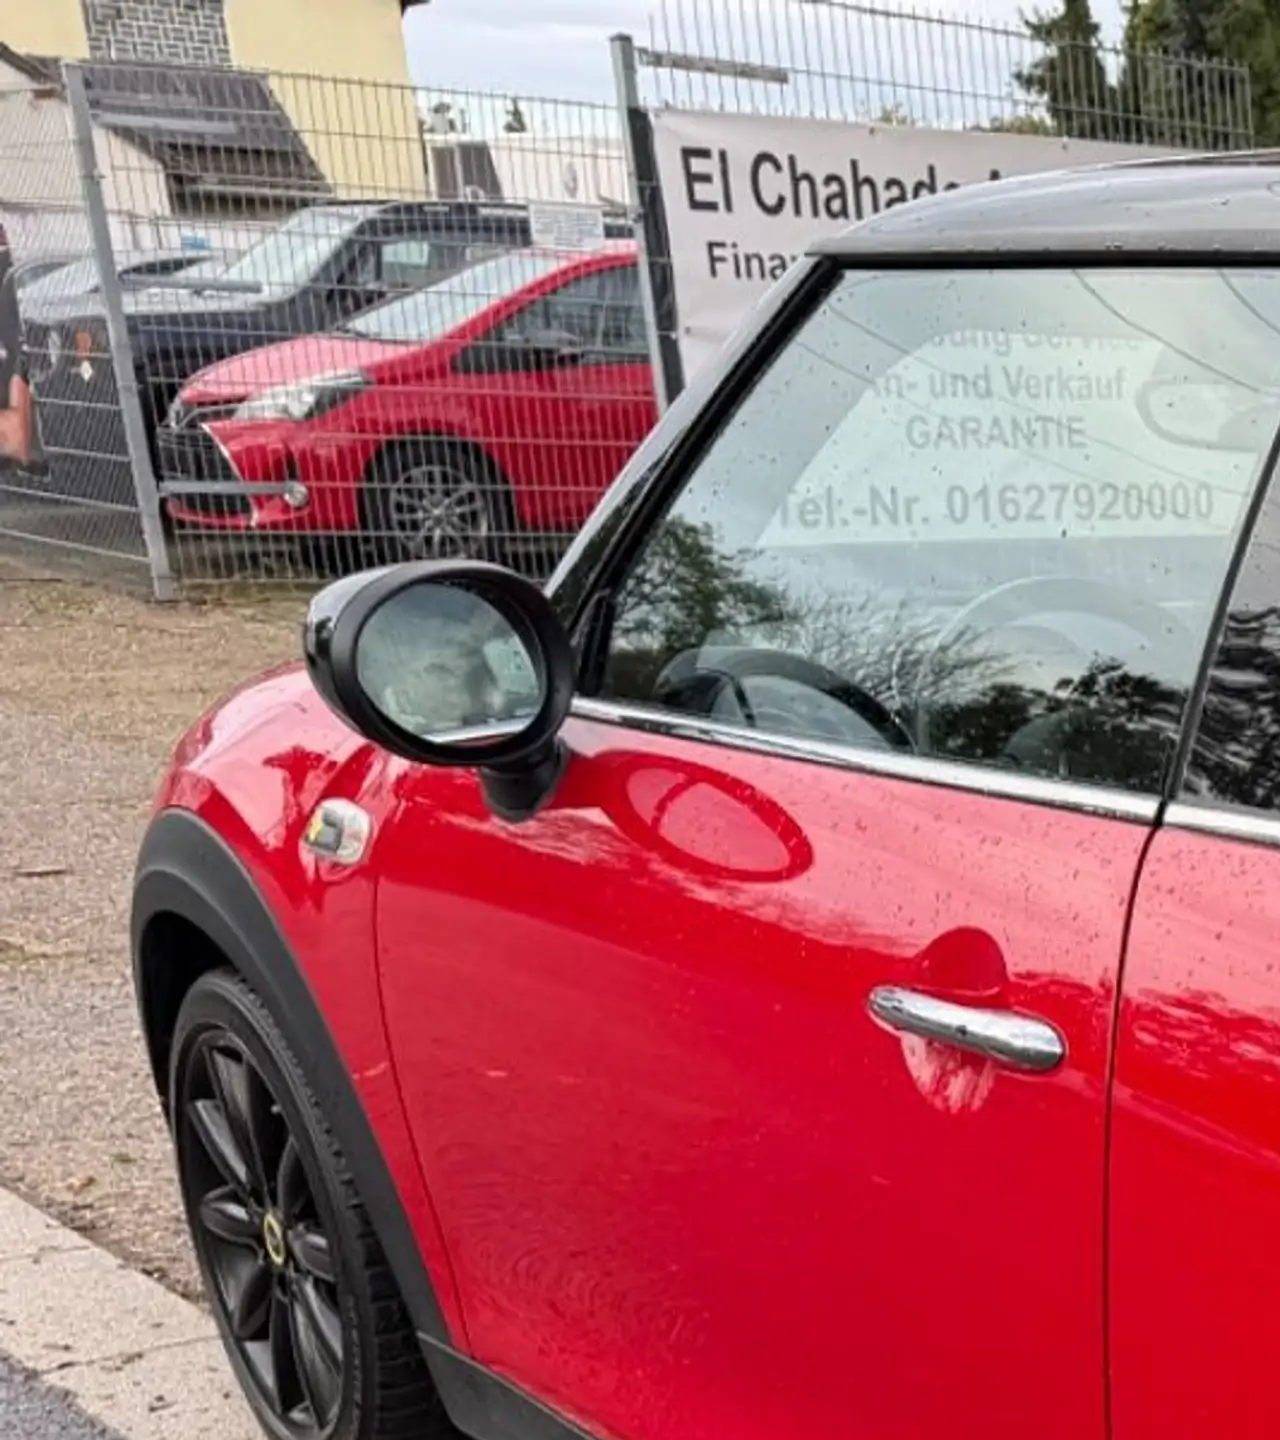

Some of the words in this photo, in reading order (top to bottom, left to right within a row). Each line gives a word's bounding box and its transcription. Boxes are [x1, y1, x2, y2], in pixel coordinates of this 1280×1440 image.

[680, 145, 734, 213] El
[706, 240, 797, 281] Fina
[928, 364, 993, 399] und
[1001, 364, 1127, 401] Verkauf
[905, 414, 1088, 450] GARANTIE
[946, 481, 1214, 525] 01627920000
